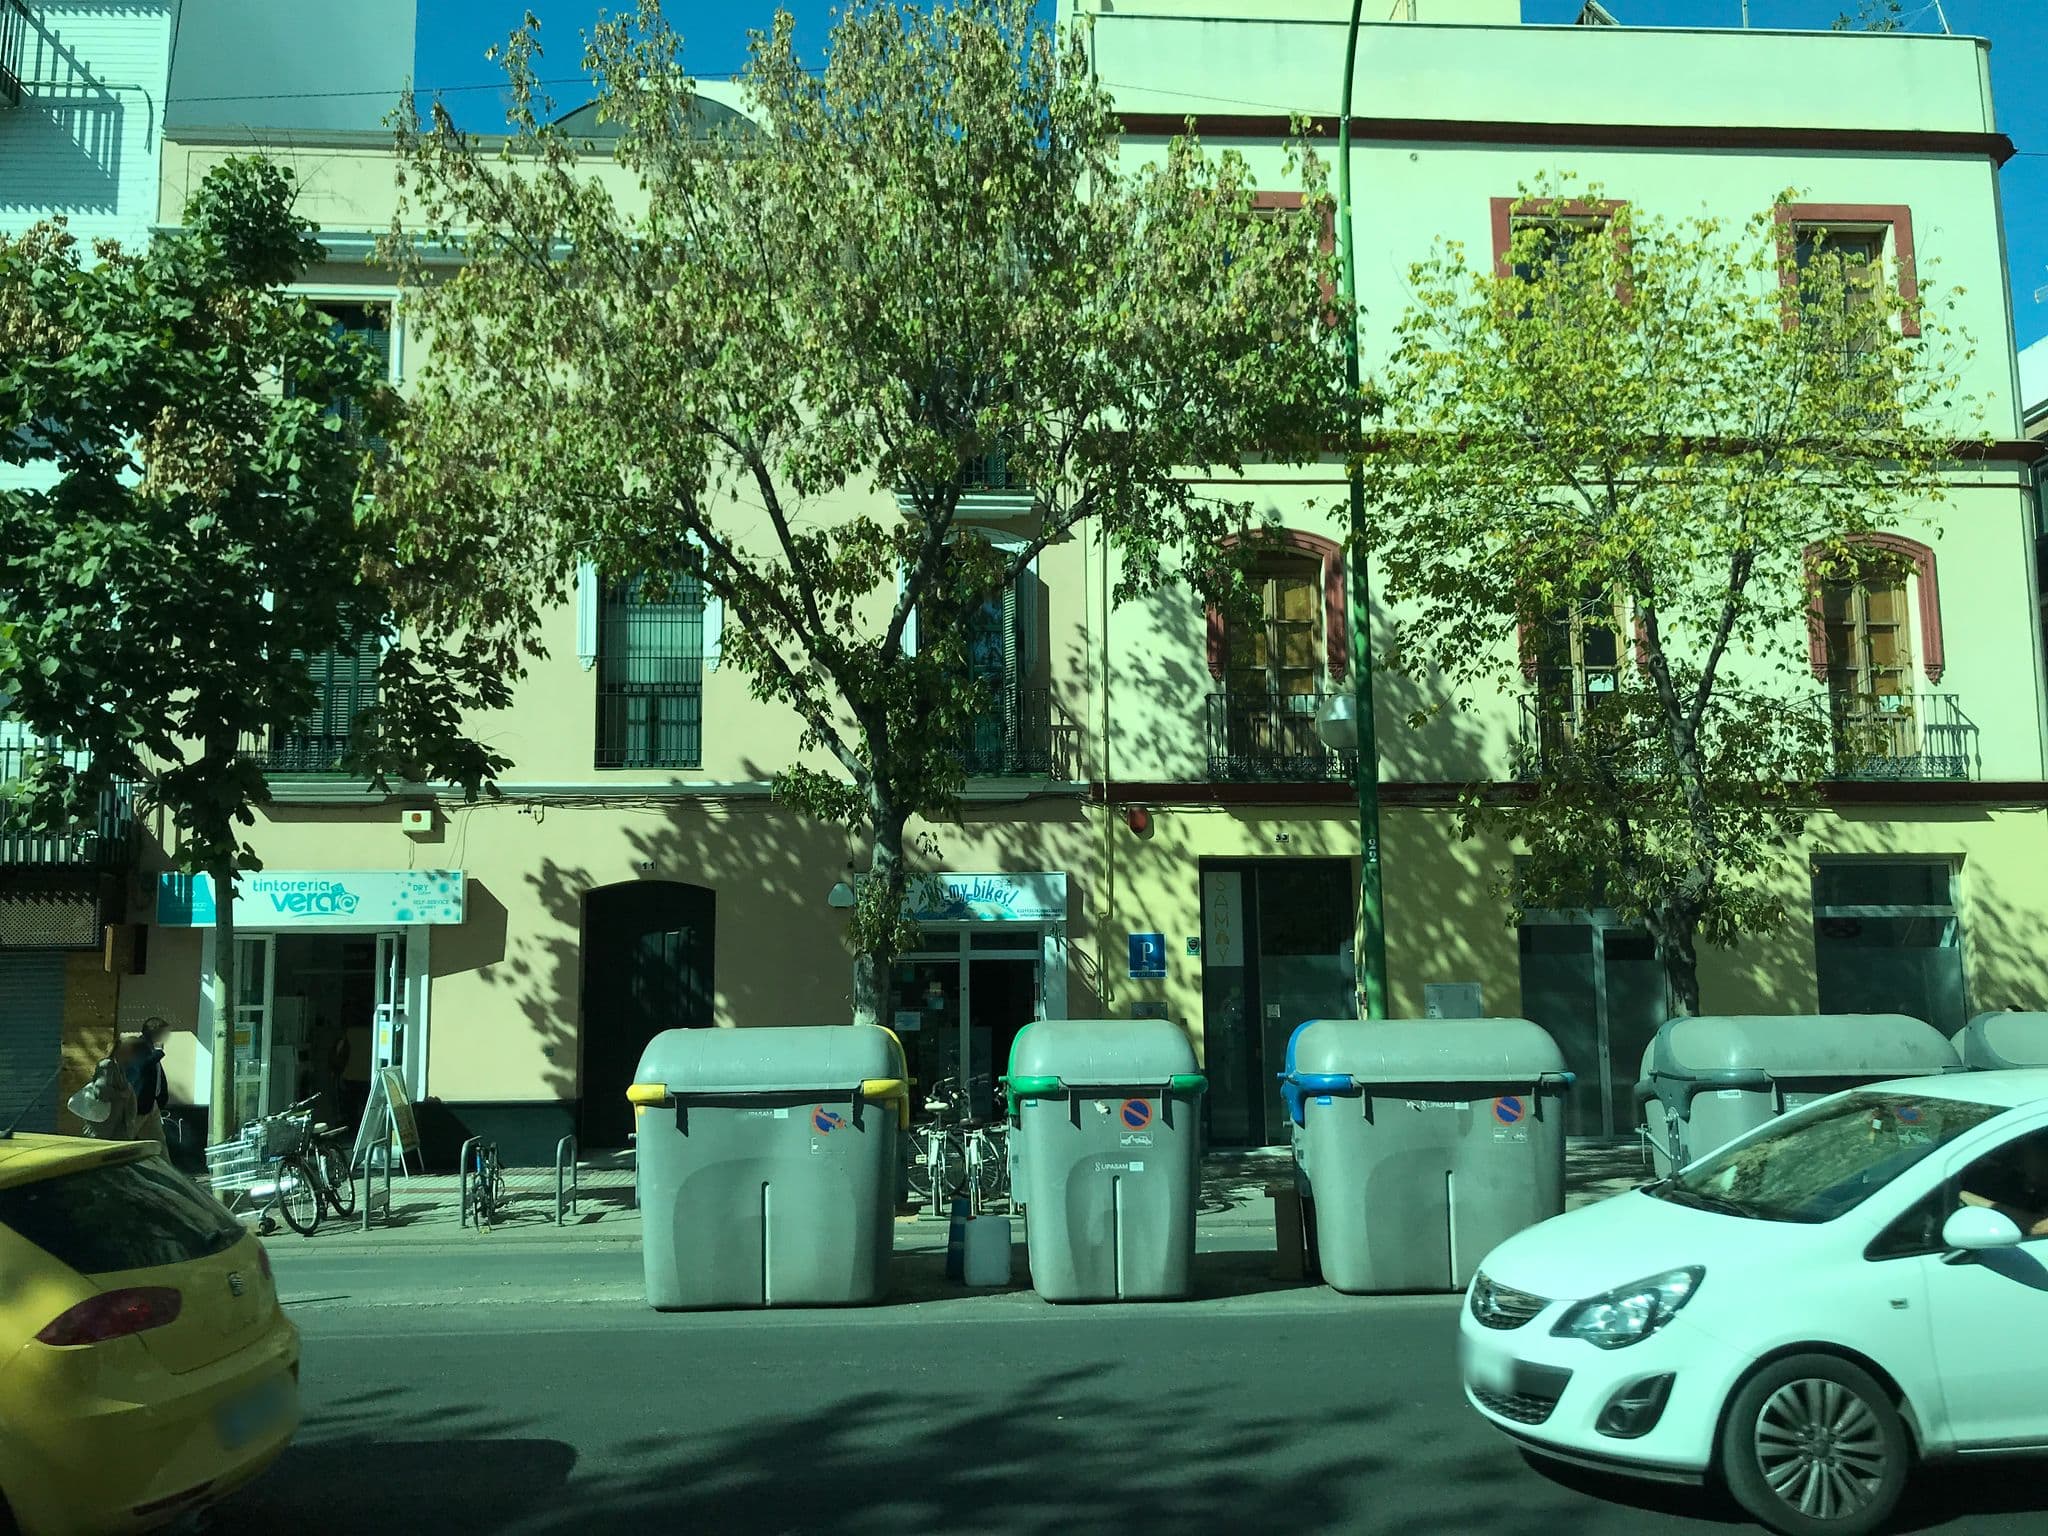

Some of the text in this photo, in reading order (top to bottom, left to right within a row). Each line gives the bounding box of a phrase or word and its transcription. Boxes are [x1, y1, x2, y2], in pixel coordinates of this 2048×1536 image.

[642, 861, 655, 870] 11
[253, 878, 330, 892] tintoreria
[948, 883, 968, 902] my
[973, 877, 1019, 907] bikes!
[1139, 941, 1154, 963] P
